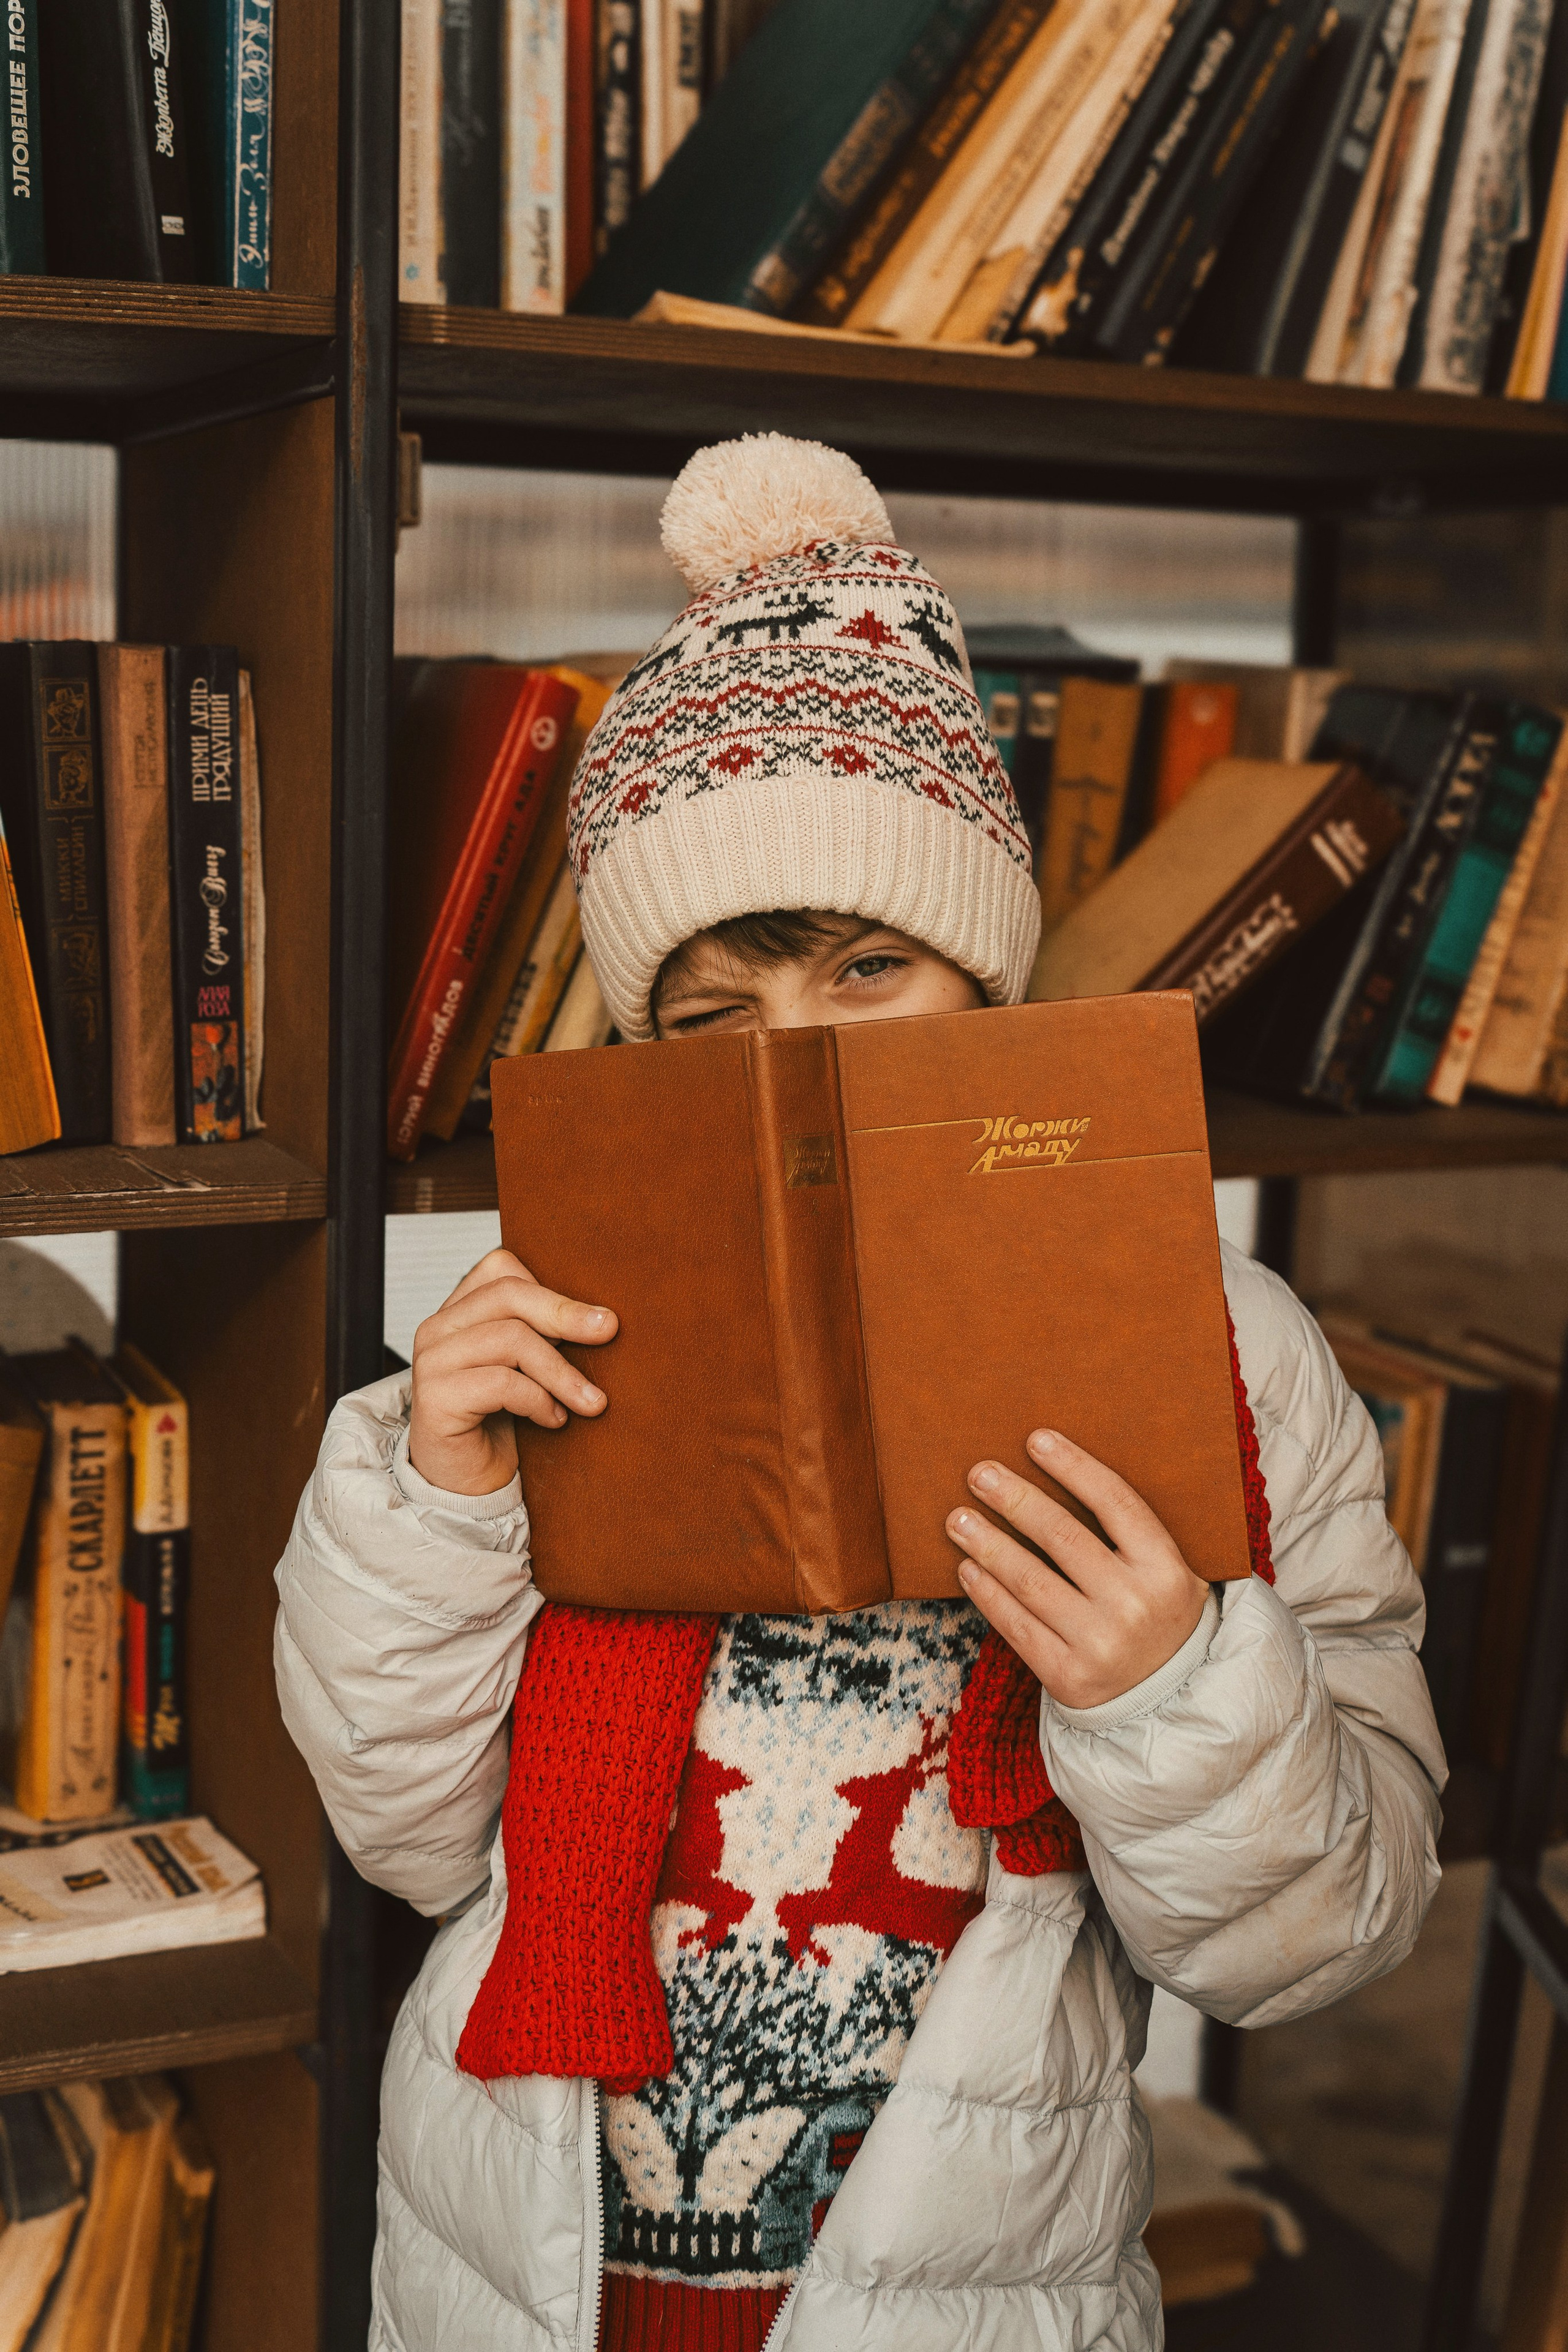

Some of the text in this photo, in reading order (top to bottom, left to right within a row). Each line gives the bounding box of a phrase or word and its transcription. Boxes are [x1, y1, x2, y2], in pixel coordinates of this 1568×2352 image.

[9, 60, 30, 198] ЗЛОВЕЩЕЕ
[154, 66, 174, 157] Жюльетта
[190, 677, 211, 802] ПРИМИ ДЕНЬ
[211, 693, 233, 802] ГРЯДУЩИЙ
[967, 1137, 1082, 1174] Амаду
[972, 1114, 1091, 1144] Жоржи
[67, 1425, 107, 1572] СКАРЛЕТТ
